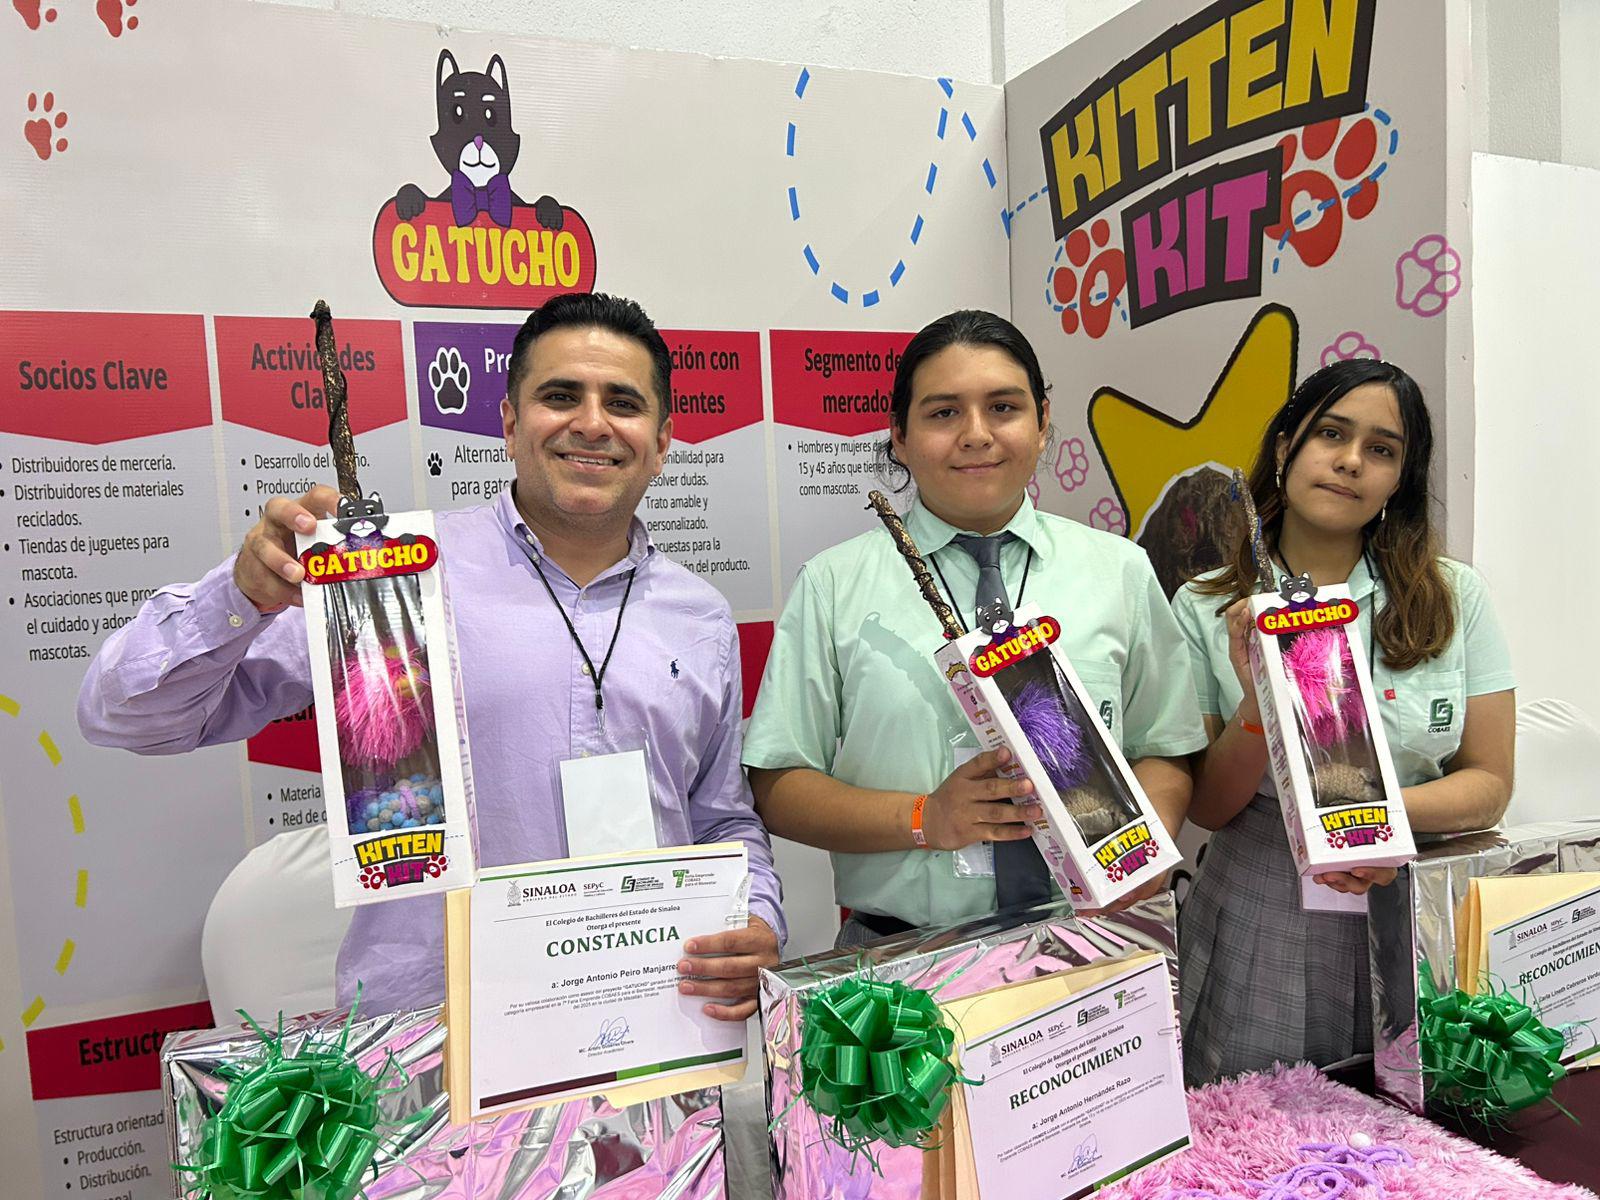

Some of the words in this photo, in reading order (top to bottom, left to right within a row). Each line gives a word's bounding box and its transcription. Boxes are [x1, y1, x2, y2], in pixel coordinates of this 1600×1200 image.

[1050, 0, 1357, 220] KITTEN
[1132, 170, 1268, 309] KIT
[392, 222, 580, 287] GATUCHO
[251, 342, 376, 371] Actividdes
[710, 350, 740, 370] con
[804, 347, 881, 378] Segmento
[19, 359, 96, 391] Socios
[103, 362, 168, 390] Clave
[798, 440, 833, 454] Hombres
[834, 444, 839, 456] y
[840, 441, 871, 455] mujeres
[12, 456, 99, 473] Distribuidores
[101, 455, 117, 472] de
[120, 454, 176, 472] mercería.
[254, 453, 310, 469] Desarrollo
[313, 453, 329, 468] del
[705, 453, 724, 467] para
[799, 462, 808, 475] 15
[810, 464, 814, 477] y
[816, 461, 825, 475] 45
[828, 461, 845, 474] años
[847, 463, 862, 477] que
[680, 473, 709, 486] dudas.
[800, 484, 821, 496] como
[823, 482, 860, 495] mascotas.
[15, 483, 100, 500] Distribuidores
[104, 482, 119, 498] de
[122, 480, 184, 497] materiales
[452, 481, 480, 500] para
[645, 496, 668, 509] Trato
[670, 494, 701, 508] amable
[703, 498, 708, 511] y
[17, 510, 82, 527] reciclados.
[18, 536, 67, 554] Tiendas
[70, 536, 85, 552] de
[88, 536, 139, 556] juguetes
[143, 536, 169, 553] para
[693, 541, 711, 554] para
[713, 537, 720, 550] la
[308, 542, 428, 578] GATUCHO
[696, 559, 709, 572] del
[711, 558, 750, 575] producto.
[22, 565, 77, 581] mascota.
[24, 590, 102, 608] Asociaciones
[105, 591, 128, 607] que
[27, 618, 37, 635] el
[41, 617, 89, 635] cuidado
[92, 618, 100, 635] y
[1264, 604, 1352, 630] GATUCHO
[29, 644, 90, 661] mascotas.
[975, 622, 1053, 671] GATUCHO
[282, 810, 303, 826] Red
[305, 808, 319, 824] de
[1320, 807, 1387, 832] KITTEN
[1095, 822, 1150, 868] KITTEN
[1345, 828, 1376, 847] KIT
[356, 834, 443, 866] KITTEN
[1120, 851, 1147, 875] KIT
[386, 862, 423, 886] KIT
[523, 883, 576, 898] SINALOA
[553, 917, 576, 926] Colegio
[585, 912, 618, 921] Bachilleres
[629, 908, 649, 916] Estado
[658, 904, 680, 912] Sinaloa
[587, 923, 607, 931] Otorga
[615, 919, 641, 929] presente
[546, 926, 680, 957] CONSTANCIA
[1517, 923, 1547, 941] SINALOA
[561, 977, 584, 987] Jorge
[586, 970, 618, 982] Antonio
[620, 969, 640, 978] Peiro
[79, 1032, 165, 1066] Estruct
[1001, 1030, 1043, 1055] SINALOA
[1028, 1060, 1046, 1073] Colegio
[1053, 1045, 1079, 1061] Bachilleres
[1076, 1046, 1097, 1061] presente
[1009, 1035, 1142, 1110] RECONOCIMIENTO
[1040, 1113, 1057, 1126] Jorge
[1059, 1100, 1083, 1116] Antonio
[1083, 1084, 1115, 1104] Hernández
[1115, 1077, 1131, 1088] Razo
[54, 1123, 114, 1145] Estructura
[77, 1141, 145, 1166] Producción.
[80, 1164, 151, 1190] Distribución.
